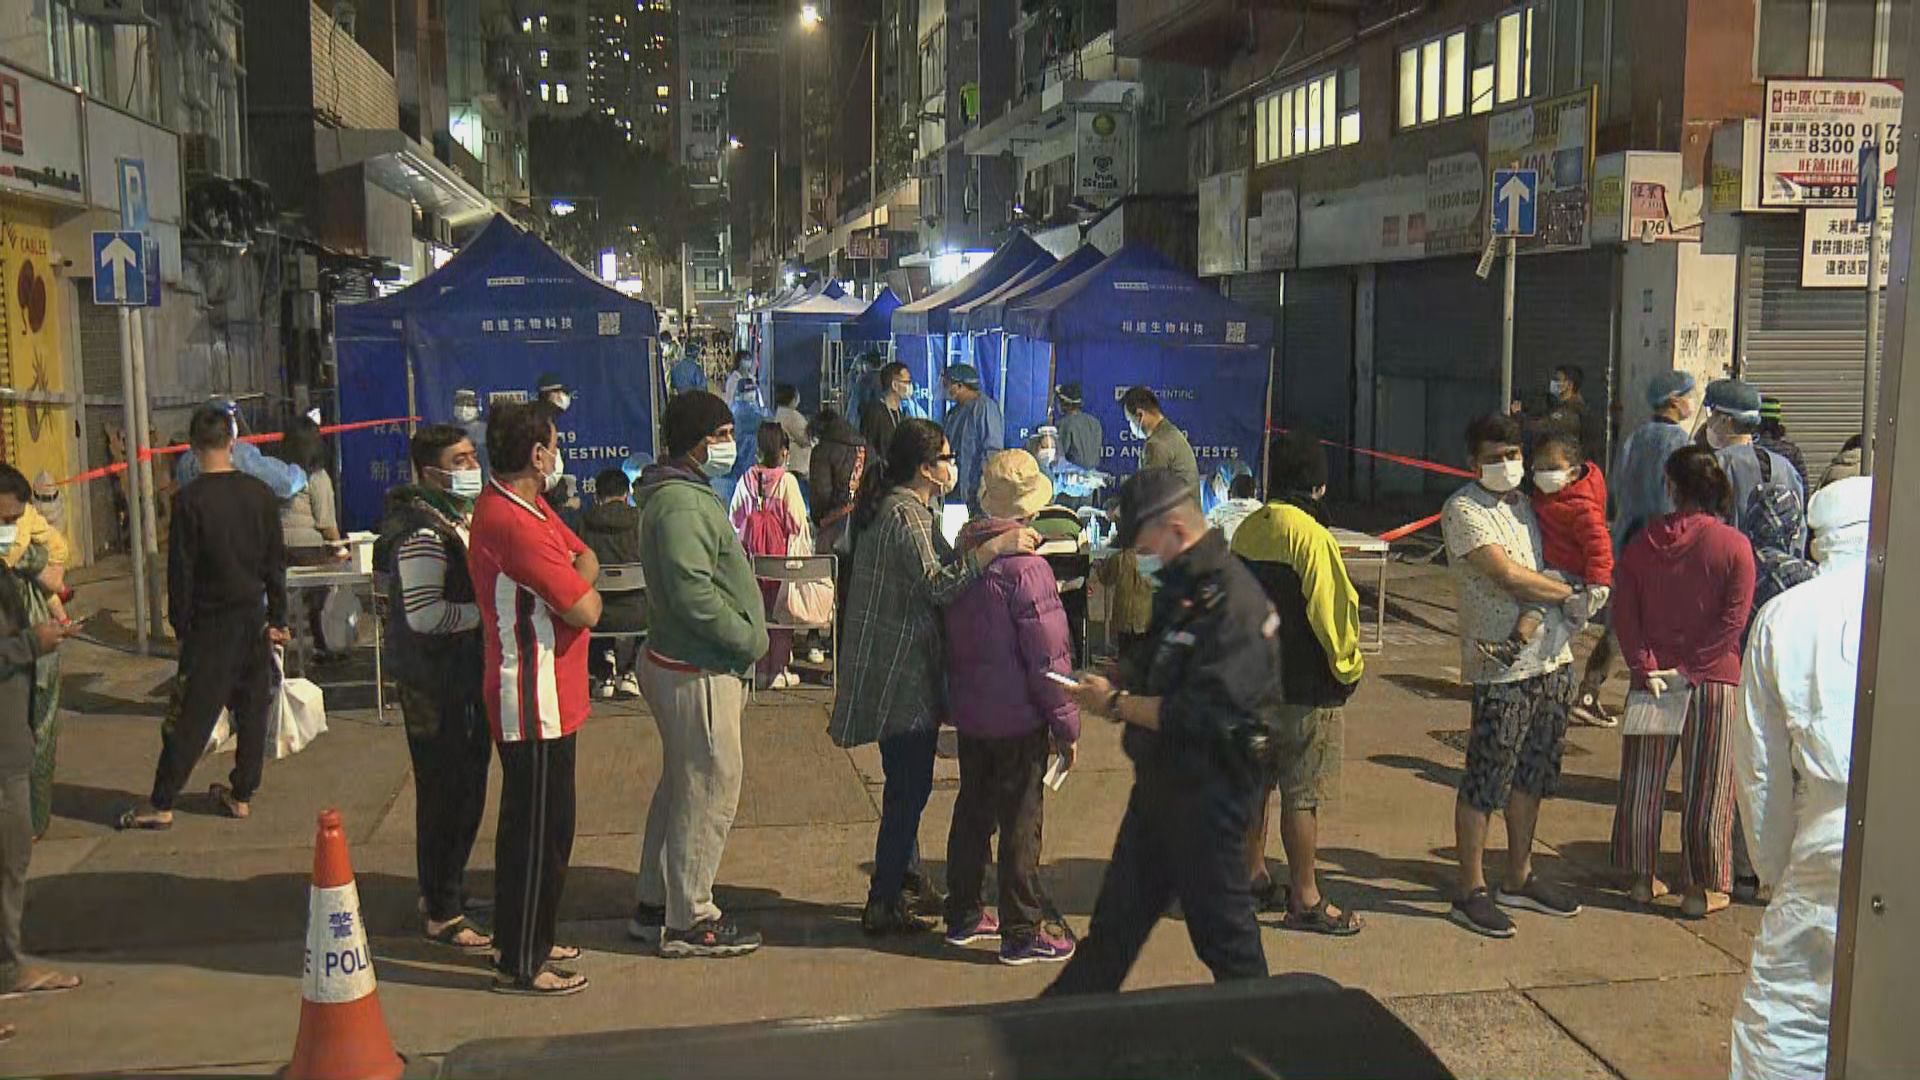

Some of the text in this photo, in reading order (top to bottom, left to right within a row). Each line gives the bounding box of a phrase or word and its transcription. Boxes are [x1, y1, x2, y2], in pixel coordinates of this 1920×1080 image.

[1809, 122, 1855, 138] 8300
[1808, 139, 1854, 154] 8300
[564, 446, 630, 460] ESTING
[328, 911, 353, 939] 警
[325, 944, 370, 977] POLI
